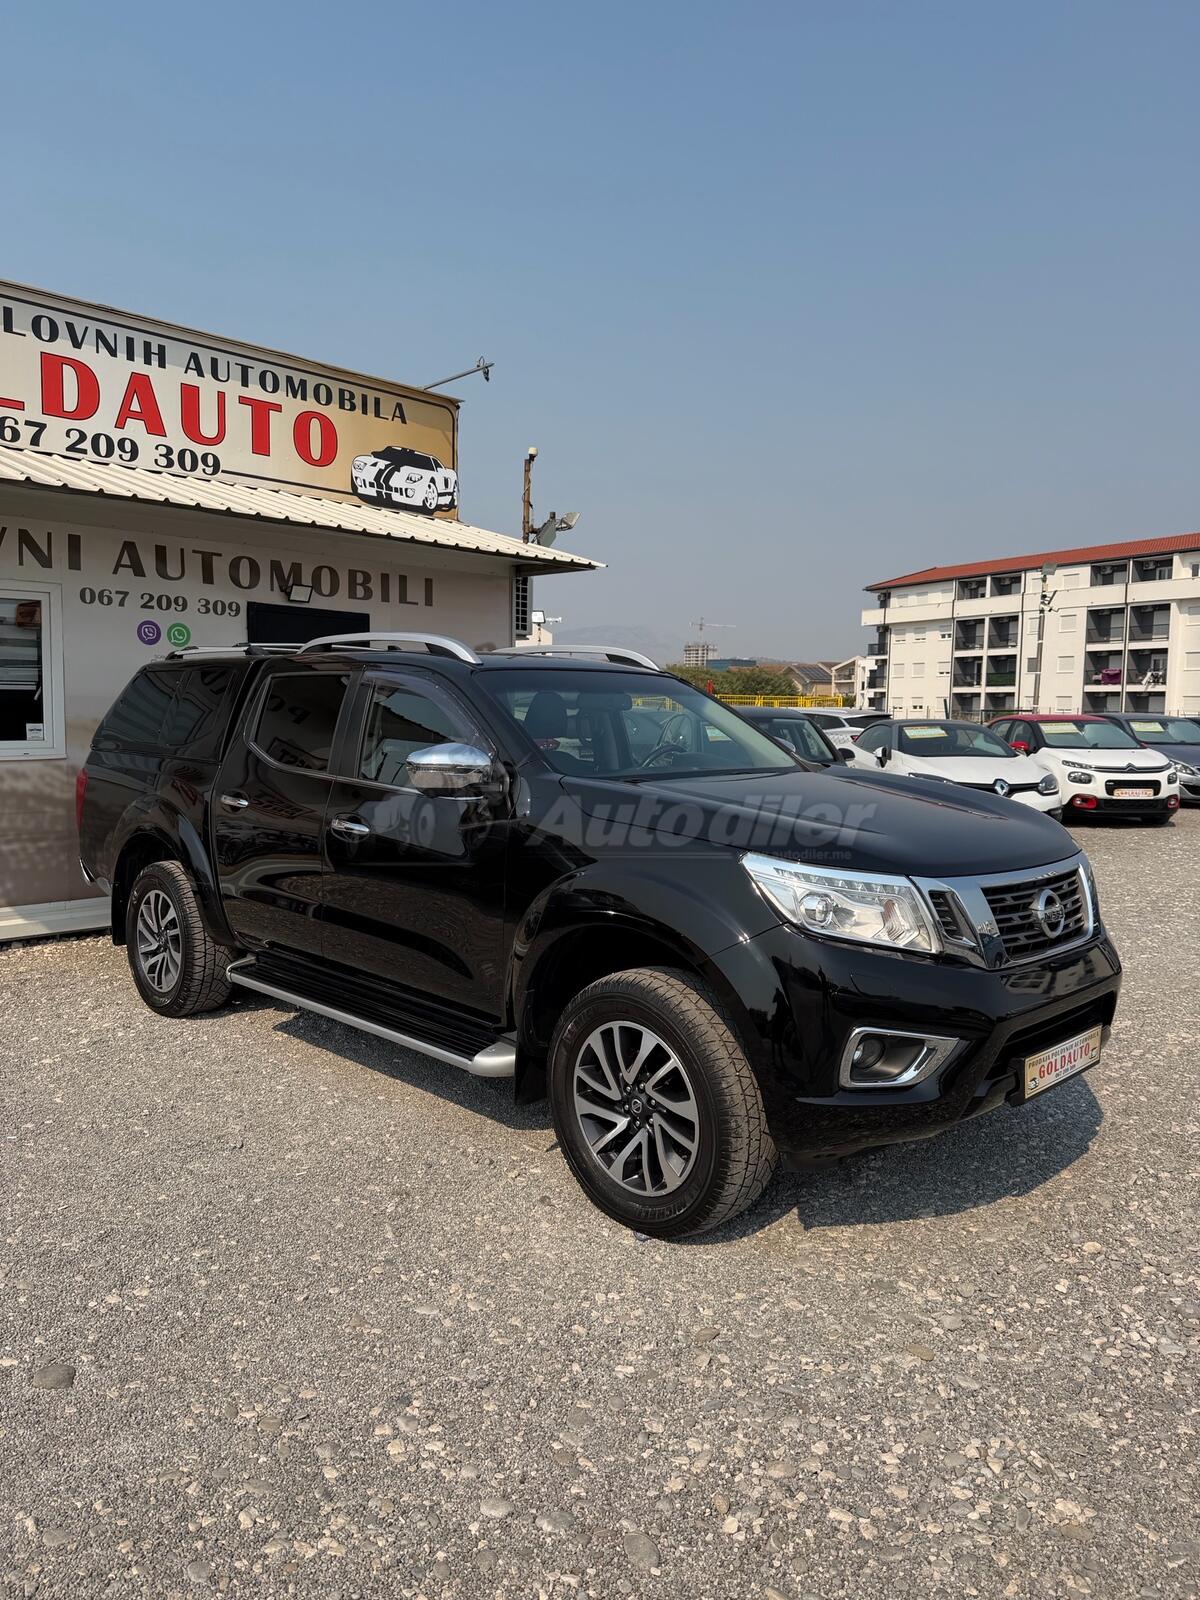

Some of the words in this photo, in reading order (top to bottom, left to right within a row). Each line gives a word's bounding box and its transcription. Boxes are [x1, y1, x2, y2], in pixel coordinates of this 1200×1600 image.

[3, 306, 166, 369] LOVNIH
[184, 352, 408, 425] AUTOMOBILA
[0, 351, 338, 468] DAUTO
[0, 416, 47, 447] 67
[65, 428, 140, 463] 209
[154, 444, 221, 476] 309
[0, 527, 82, 571] NI
[112, 540, 434, 607] AUTOMOBILI
[79, 587, 130, 607] 067
[140, 592, 188, 612] 209
[197, 598, 241, 617] 309
[1039, 1042, 1091, 1079] GOLDAUTO
